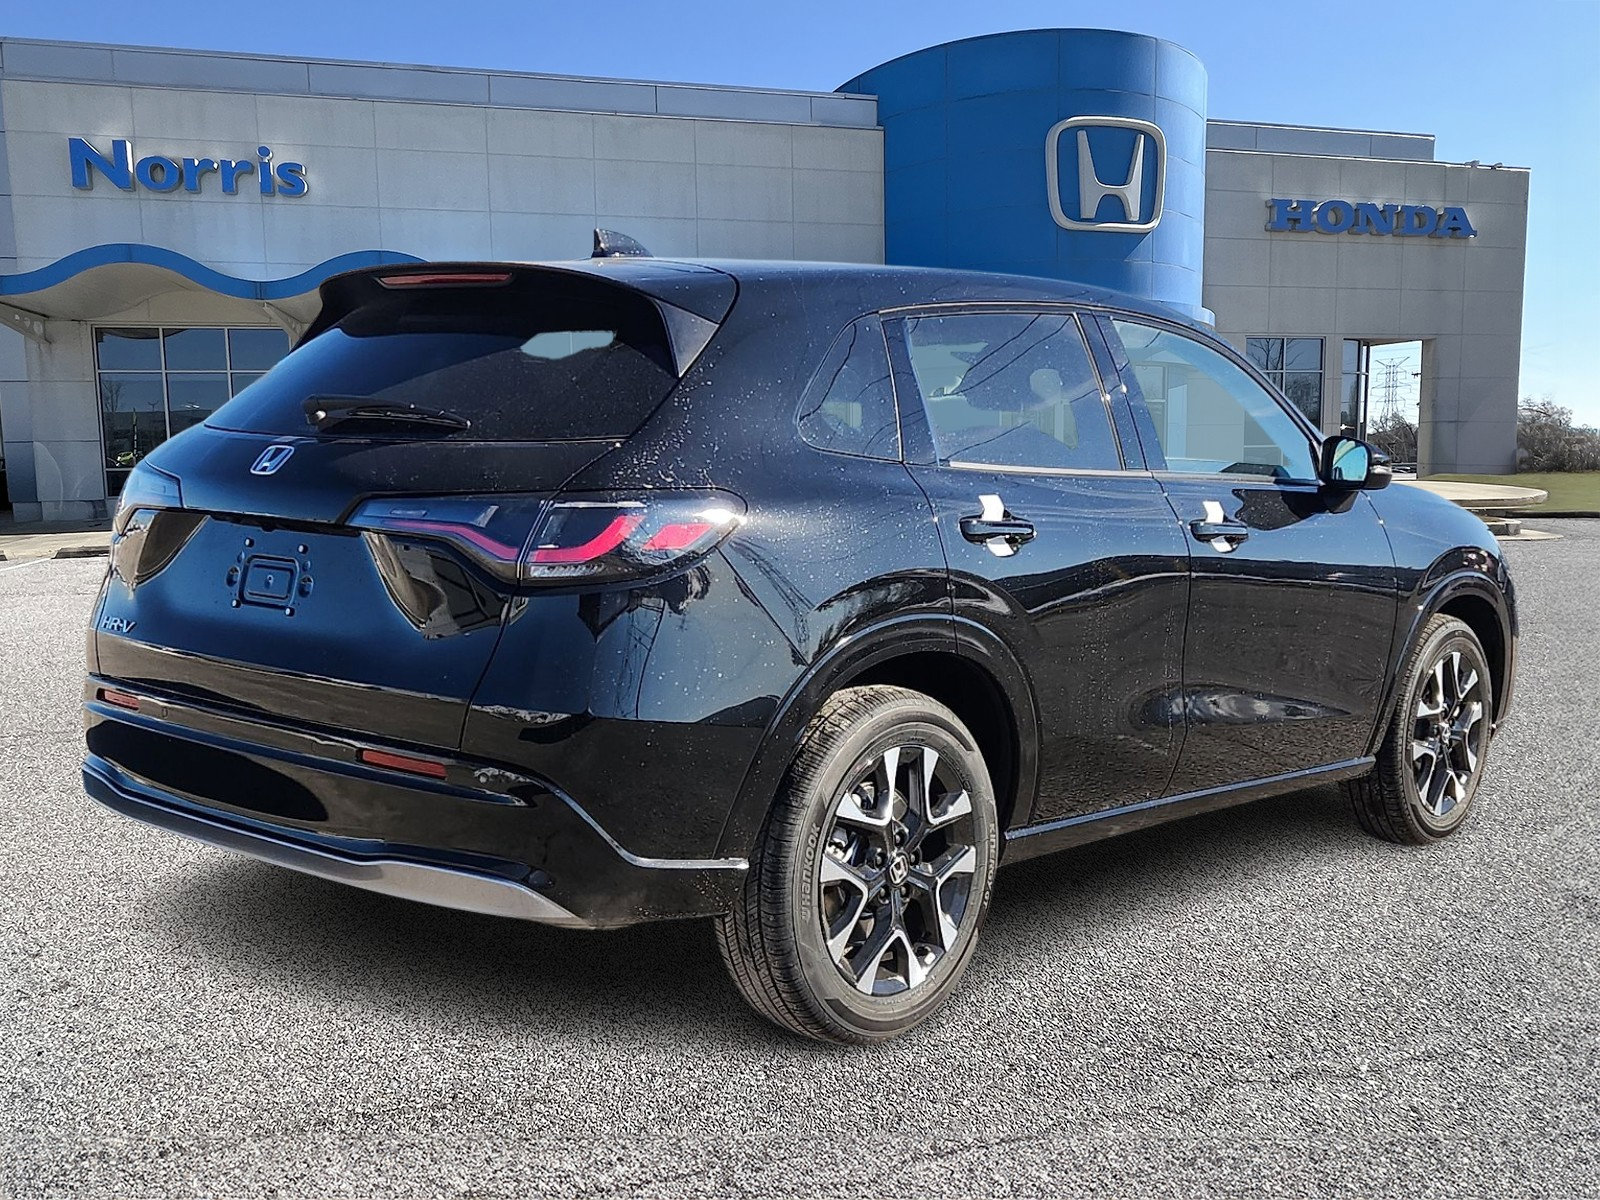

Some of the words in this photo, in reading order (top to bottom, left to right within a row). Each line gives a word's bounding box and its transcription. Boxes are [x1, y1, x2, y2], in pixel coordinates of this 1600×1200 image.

[68, 137, 309, 197] Norris
[1265, 198, 1478, 239] HONDA
[101, 615, 137, 633] HR-V
